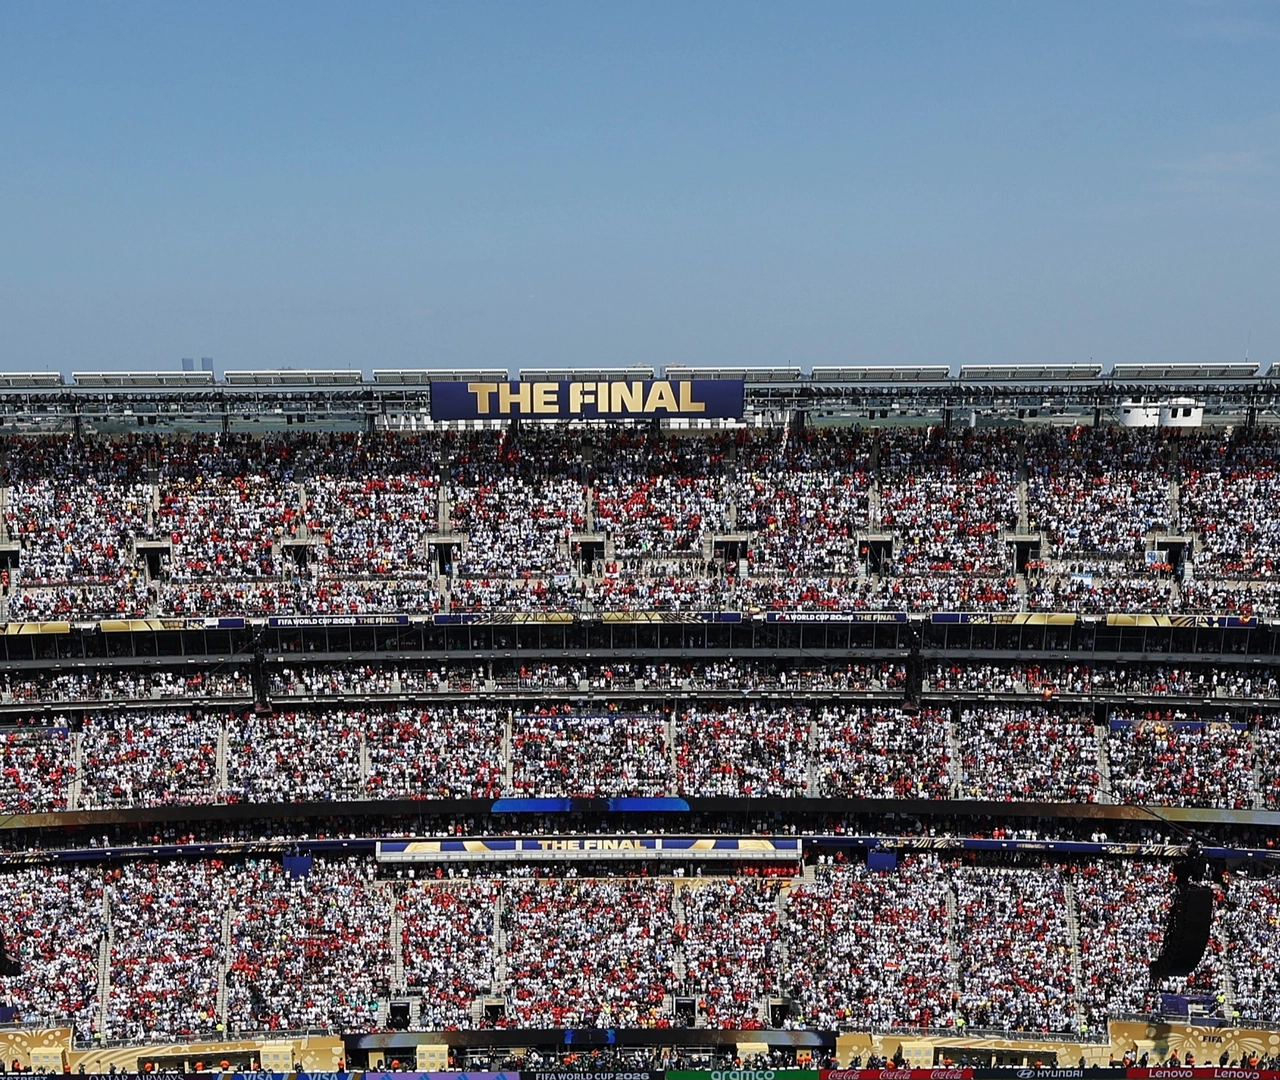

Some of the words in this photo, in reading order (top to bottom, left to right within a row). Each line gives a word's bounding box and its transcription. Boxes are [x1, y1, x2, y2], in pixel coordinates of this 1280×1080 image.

[468, 382, 558, 414] THE
[569, 381, 705, 413] FINAL
[538, 840, 580, 850] THE
[584, 840, 648, 850] FINAL
[1202, 1035, 1223, 1043] FIFA
[615, 1072, 650, 1080] 2026
[710, 1071, 775, 1080] aramco
[1037, 1070, 1083, 1078] HYUNDAI
[1149, 1069, 1193, 1079] Lenovo
[1214, 1069, 1260, 1080] Lenovo
